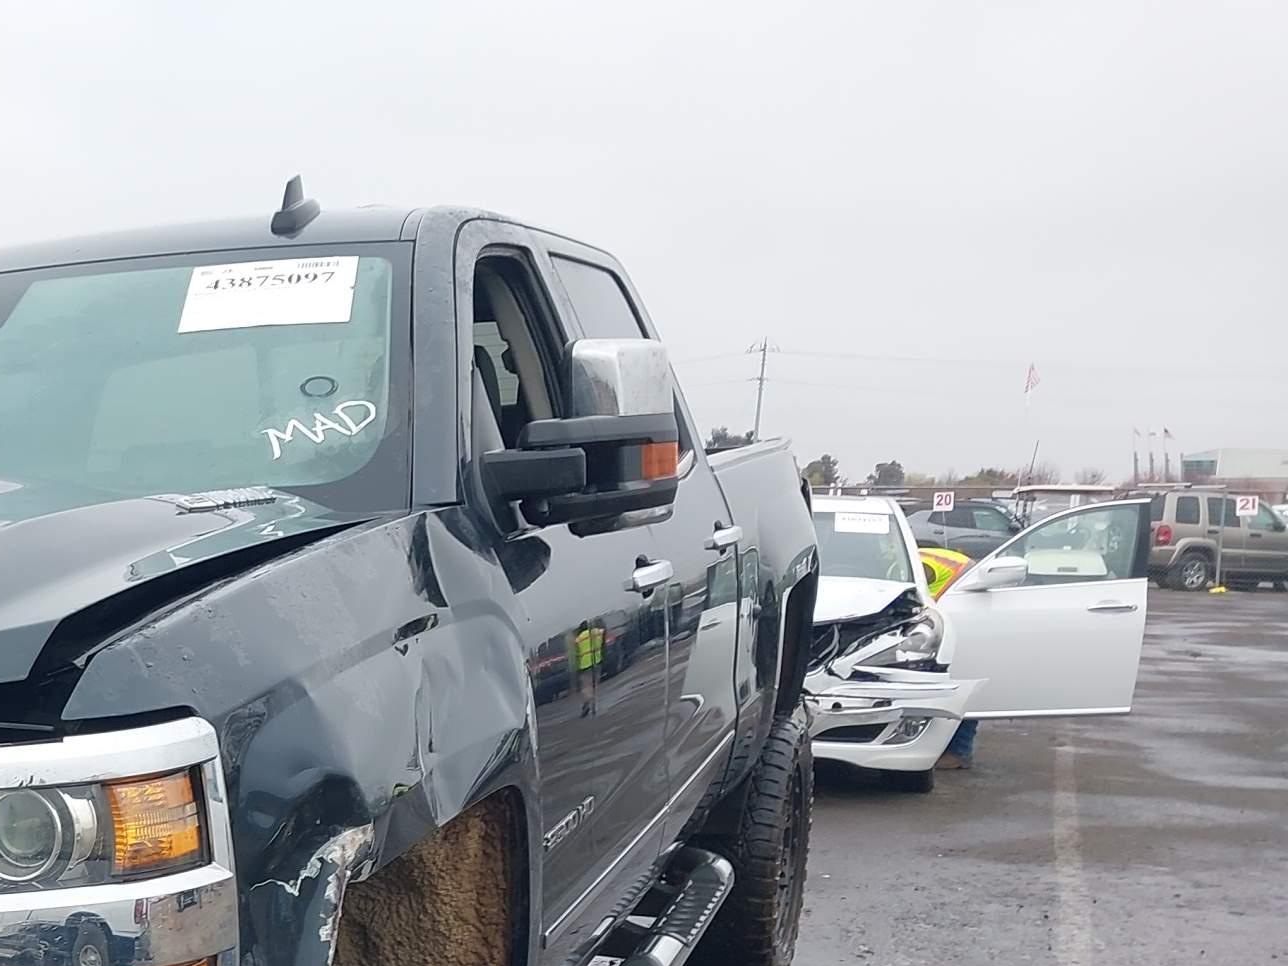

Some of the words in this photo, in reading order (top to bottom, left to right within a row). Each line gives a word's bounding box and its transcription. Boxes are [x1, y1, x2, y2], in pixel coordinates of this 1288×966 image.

[205, 271, 336, 291] 43875097
[260, 400, 376, 460] MAD
[936, 493, 952, 506] 20
[1239, 497, 1256, 510] 21
